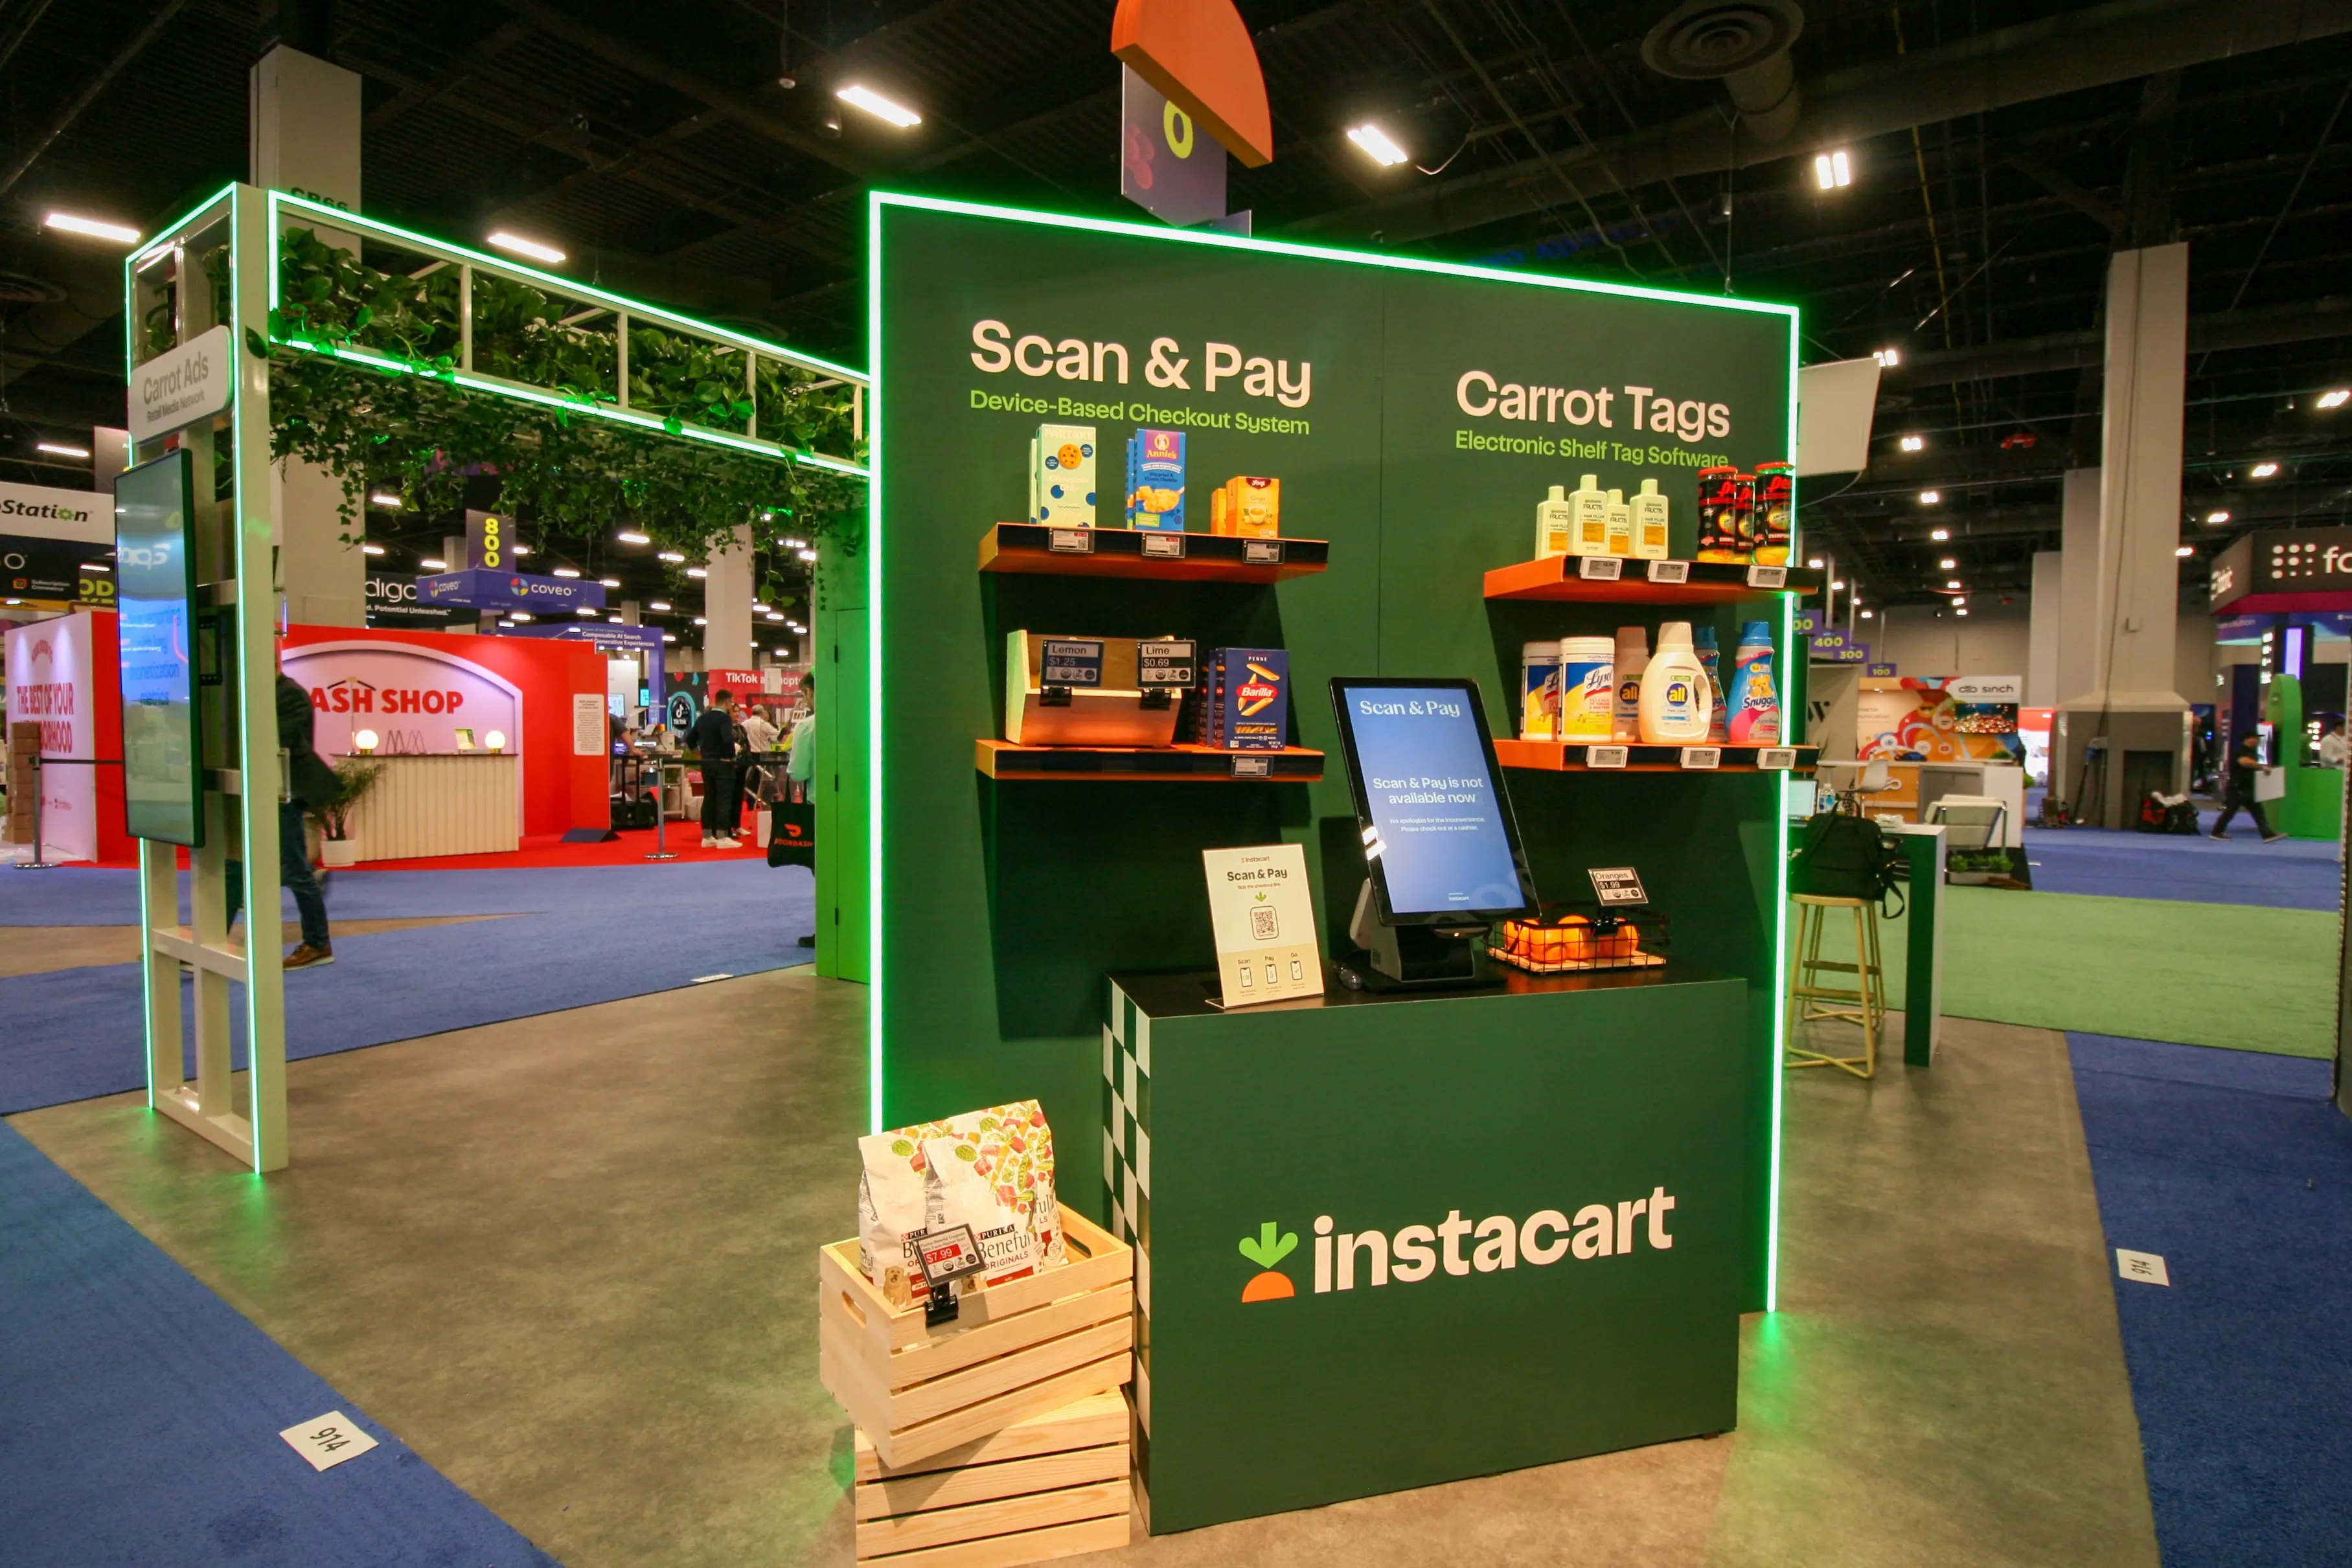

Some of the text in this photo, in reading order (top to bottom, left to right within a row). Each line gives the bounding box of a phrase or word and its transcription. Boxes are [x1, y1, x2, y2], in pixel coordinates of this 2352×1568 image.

[971, 319, 1311, 409] Scan & Pay
[144, 351, 209, 405] Carrot Ads
[163, 398, 179, 416] Media
[180, 389, 205, 411] Network
[1457, 370, 1730, 442] Carrot Tags
[970, 390, 1310, 435] Device-Based Checkout System
[1045, 429, 1094, 440] PARTAKE
[1146, 449, 1177, 459] Annie's
[1456, 430, 1729, 469] Electronic Shelf Tag Software
[1049, 475, 1089, 484] Chocolate
[1060, 484, 1079, 492] Chip
[484, 517, 500, 568] 800
[439, 581, 460, 593] coveo
[531, 584, 572, 597] coveo
[375, 605, 408, 613] Potential
[1793, 619, 1813, 631] 00
[1814, 637, 1844, 648] 400
[1052, 645, 1087, 654] Lemon
[1146, 646, 1170, 655] Lime
[1839, 650, 1864, 659] 300
[1049, 657, 1076, 666] $1.25
[1143, 658, 1169, 668] $0.69
[725, 672, 758, 685] TikTok
[1242, 687, 1273, 698] Barilla
[1621, 686, 1639, 701] all
[1669, 687, 1686, 703] all
[1981, 684, 2015, 694] sinch
[17, 683, 74, 715] THE BEST OF YOUR
[311, 687, 464, 714] ASH SHOP
[1360, 700, 1460, 717] Scan & Pay
[1373, 777, 1483, 790] Scan & Pay is not
[1389, 791, 1476, 804] available now
[1227, 869, 1288, 881] Scan & Pay
[1599, 881, 1621, 890] $1.99
[977, 1231, 1031, 1260] Beneful
[1314, 1186, 1675, 1294] instacart
[926, 1247, 953, 1264] $7.99
[309, 1427, 351, 1453] 914
